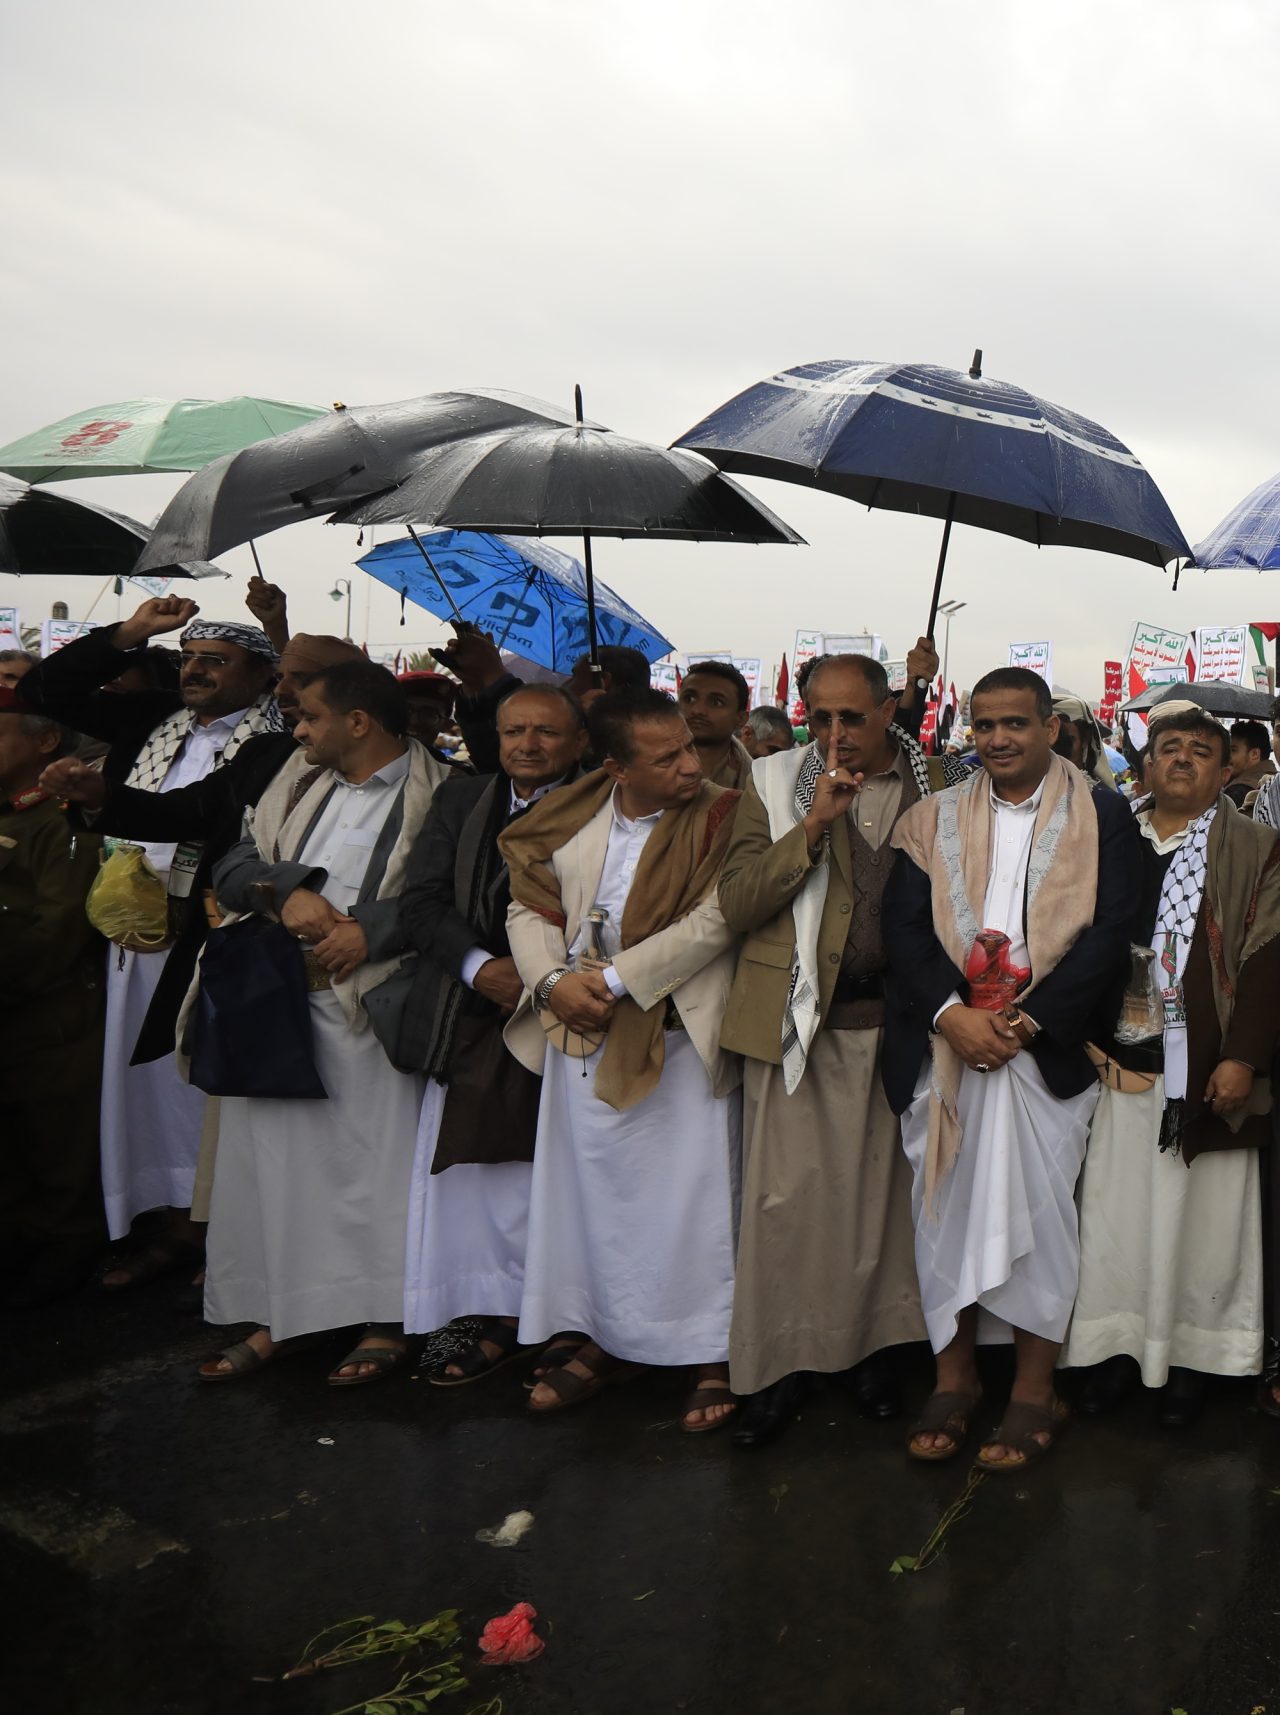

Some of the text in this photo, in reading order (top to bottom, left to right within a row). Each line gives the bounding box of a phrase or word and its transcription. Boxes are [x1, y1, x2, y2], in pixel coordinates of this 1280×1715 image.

[1137, 632, 1184, 650] الله أكبر
[1204, 630, 1243, 646] الله أكبر
[1014, 646, 1034, 662] أكبر
[1225, 646, 1243, 655] الموت
